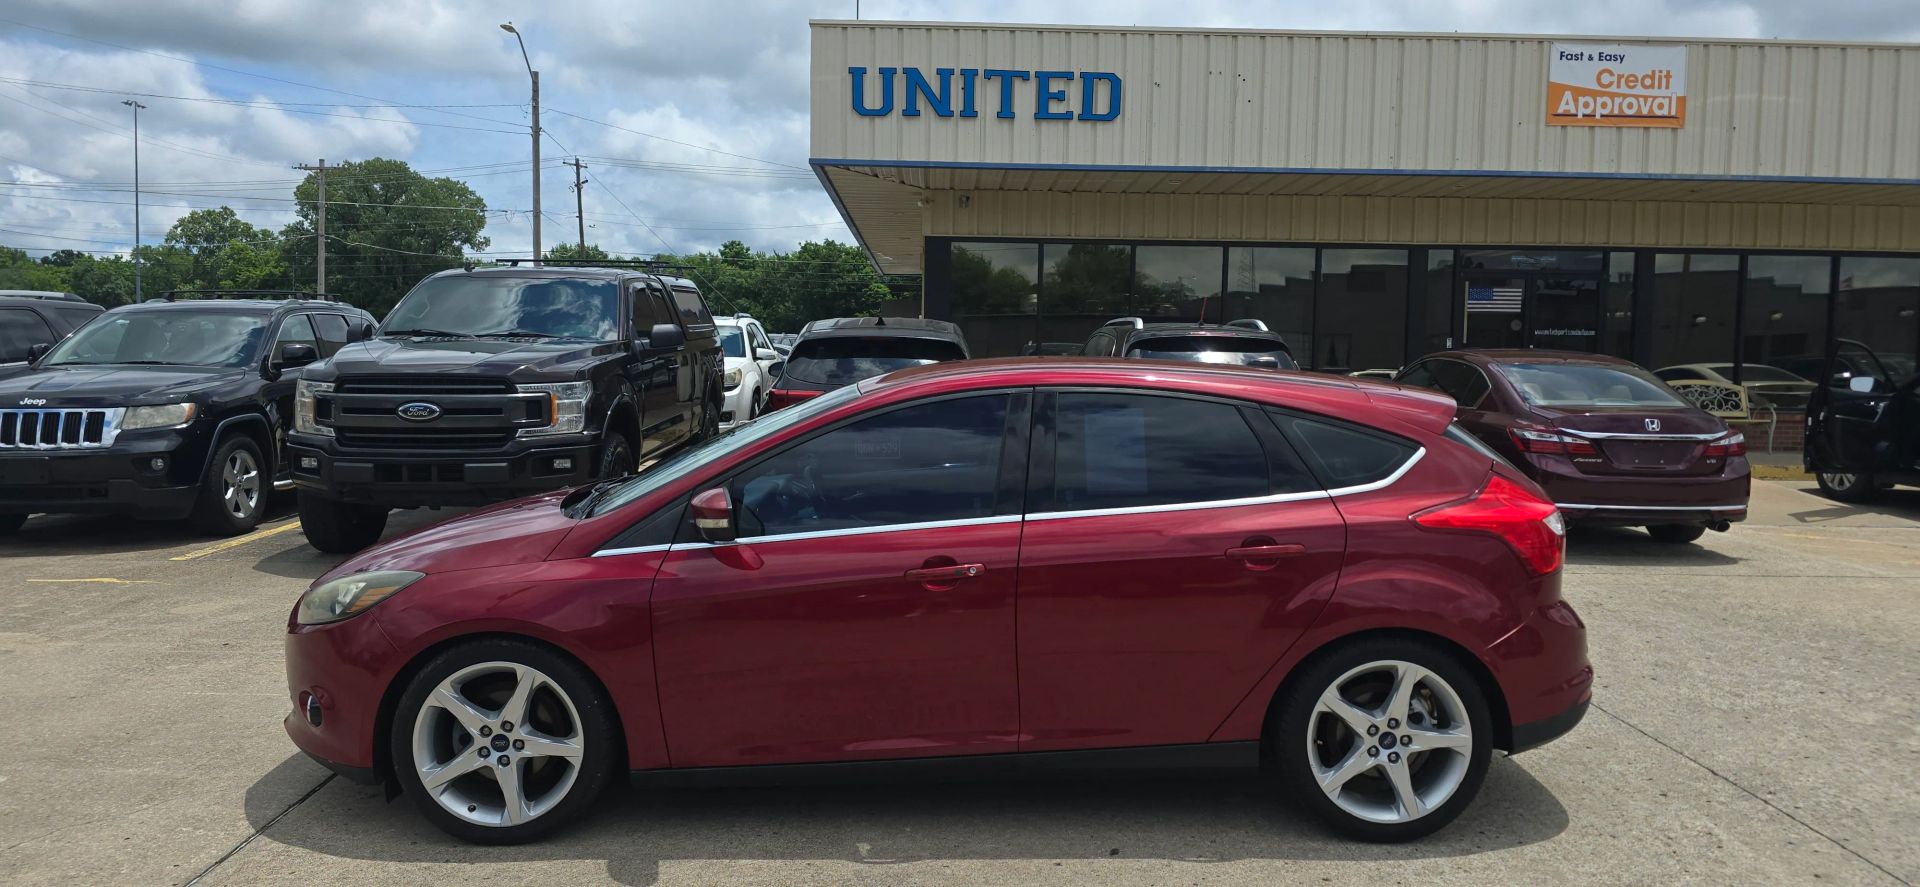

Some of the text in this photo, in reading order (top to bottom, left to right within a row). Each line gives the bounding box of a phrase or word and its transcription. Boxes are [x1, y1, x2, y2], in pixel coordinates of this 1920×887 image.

[1559, 51, 1625, 64] Fast & Easy
[1595, 68, 1673, 90] Credit
[848, 66, 1122, 122] UNITED
[1556, 90, 1677, 119] Approval
[19, 397, 47, 406] Jeep
[407, 406, 430, 416] Ford
